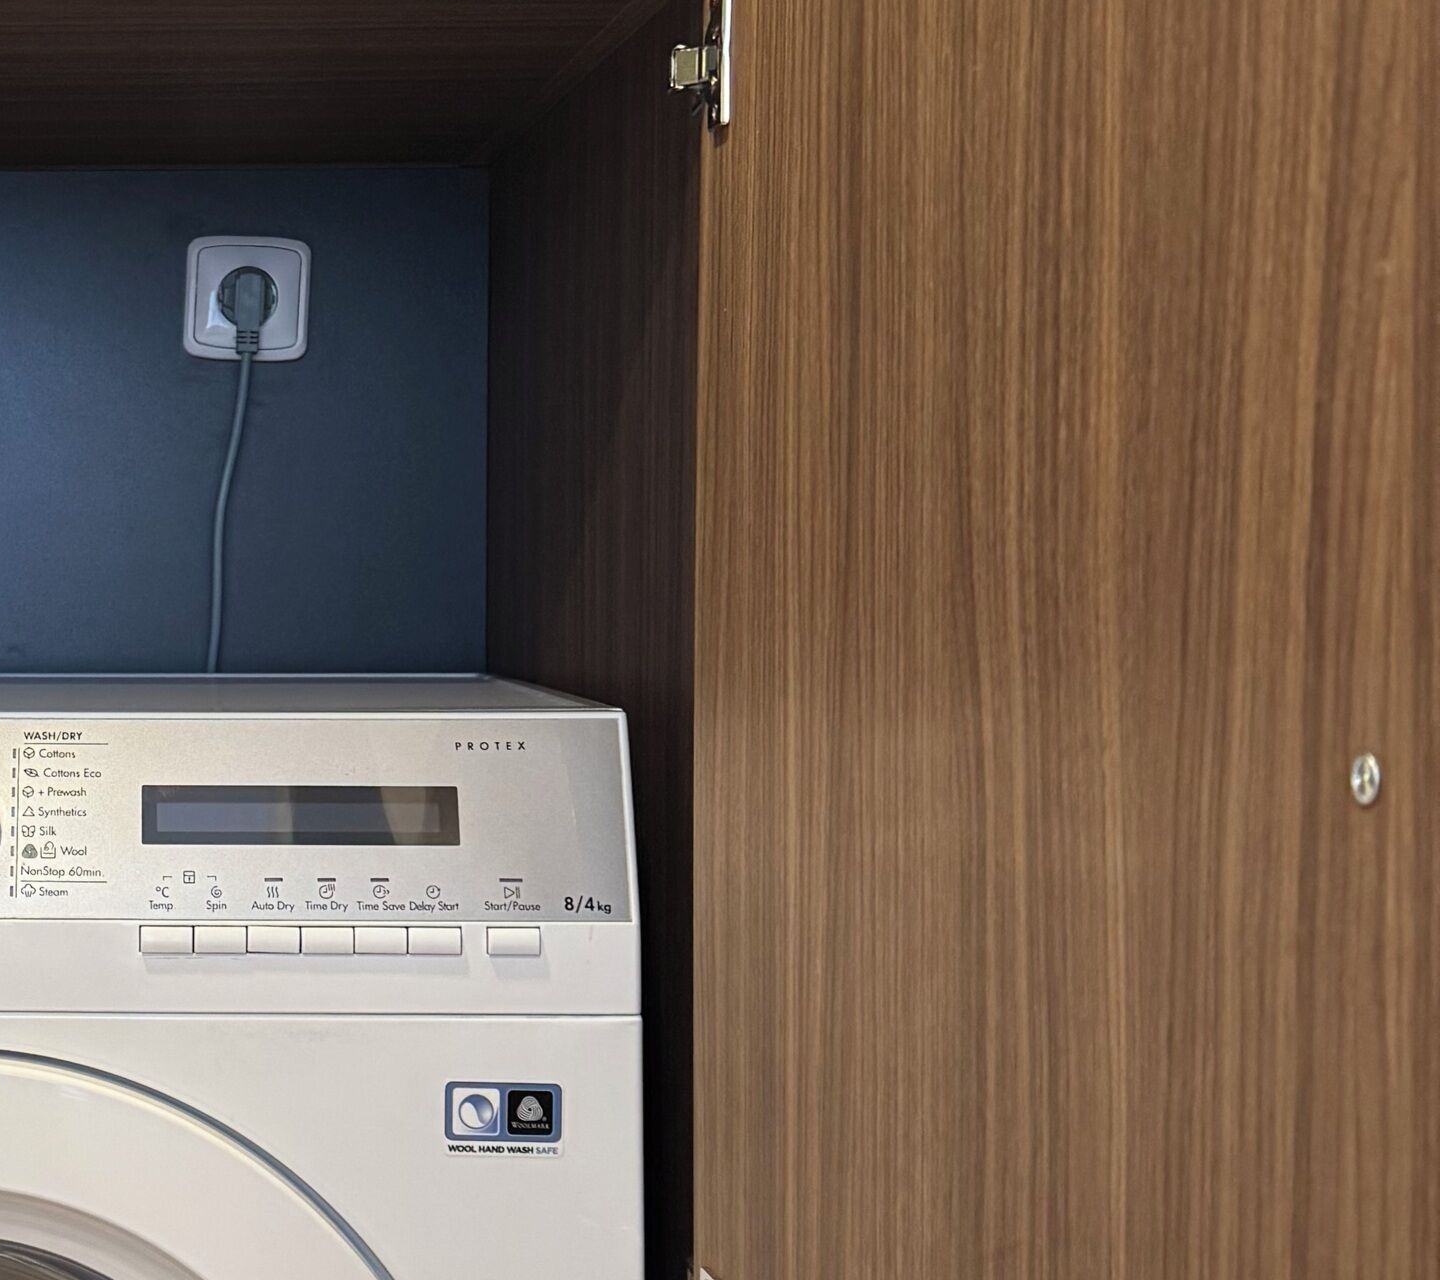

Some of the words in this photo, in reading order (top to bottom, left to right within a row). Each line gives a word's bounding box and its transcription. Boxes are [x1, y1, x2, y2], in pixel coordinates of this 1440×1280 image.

[24, 732, 82, 741] WASH/DRY
[454, 741, 527, 751] PROTEX
[39, 748, 76, 758] Cottons
[44, 768, 80, 778] Cottons
[84, 768, 102, 778] Eco
[48, 786, 87, 797] Prewash
[38, 806, 87, 818] Synthetics
[40, 826, 56, 836] Silk
[60, 846, 87, 856] Wool
[20, 866, 65, 878] NonStop
[69, 866, 105, 877] 60min.
[39, 886, 69, 896] Steam
[206, 900, 227, 912] Spin
[252, 901, 274, 911] Auto
[277, 901, 295, 912] Dry
[305, 901, 328, 911] Time
[330, 901, 349, 912] Dry
[357, 901, 379, 911] Time
[382, 901, 406, 911] Save
[410, 901, 435, 913] Delay
[438, 901, 459, 911] Start
[484, 900, 541, 912] Start/Pause
[564, 896, 595, 913] 8/4
[598, 901, 612, 914] kg
[448, 1144, 477, 1153] WOOL
[506, 1146, 533, 1154] WASH
[536, 1147, 558, 1155] SAFE
